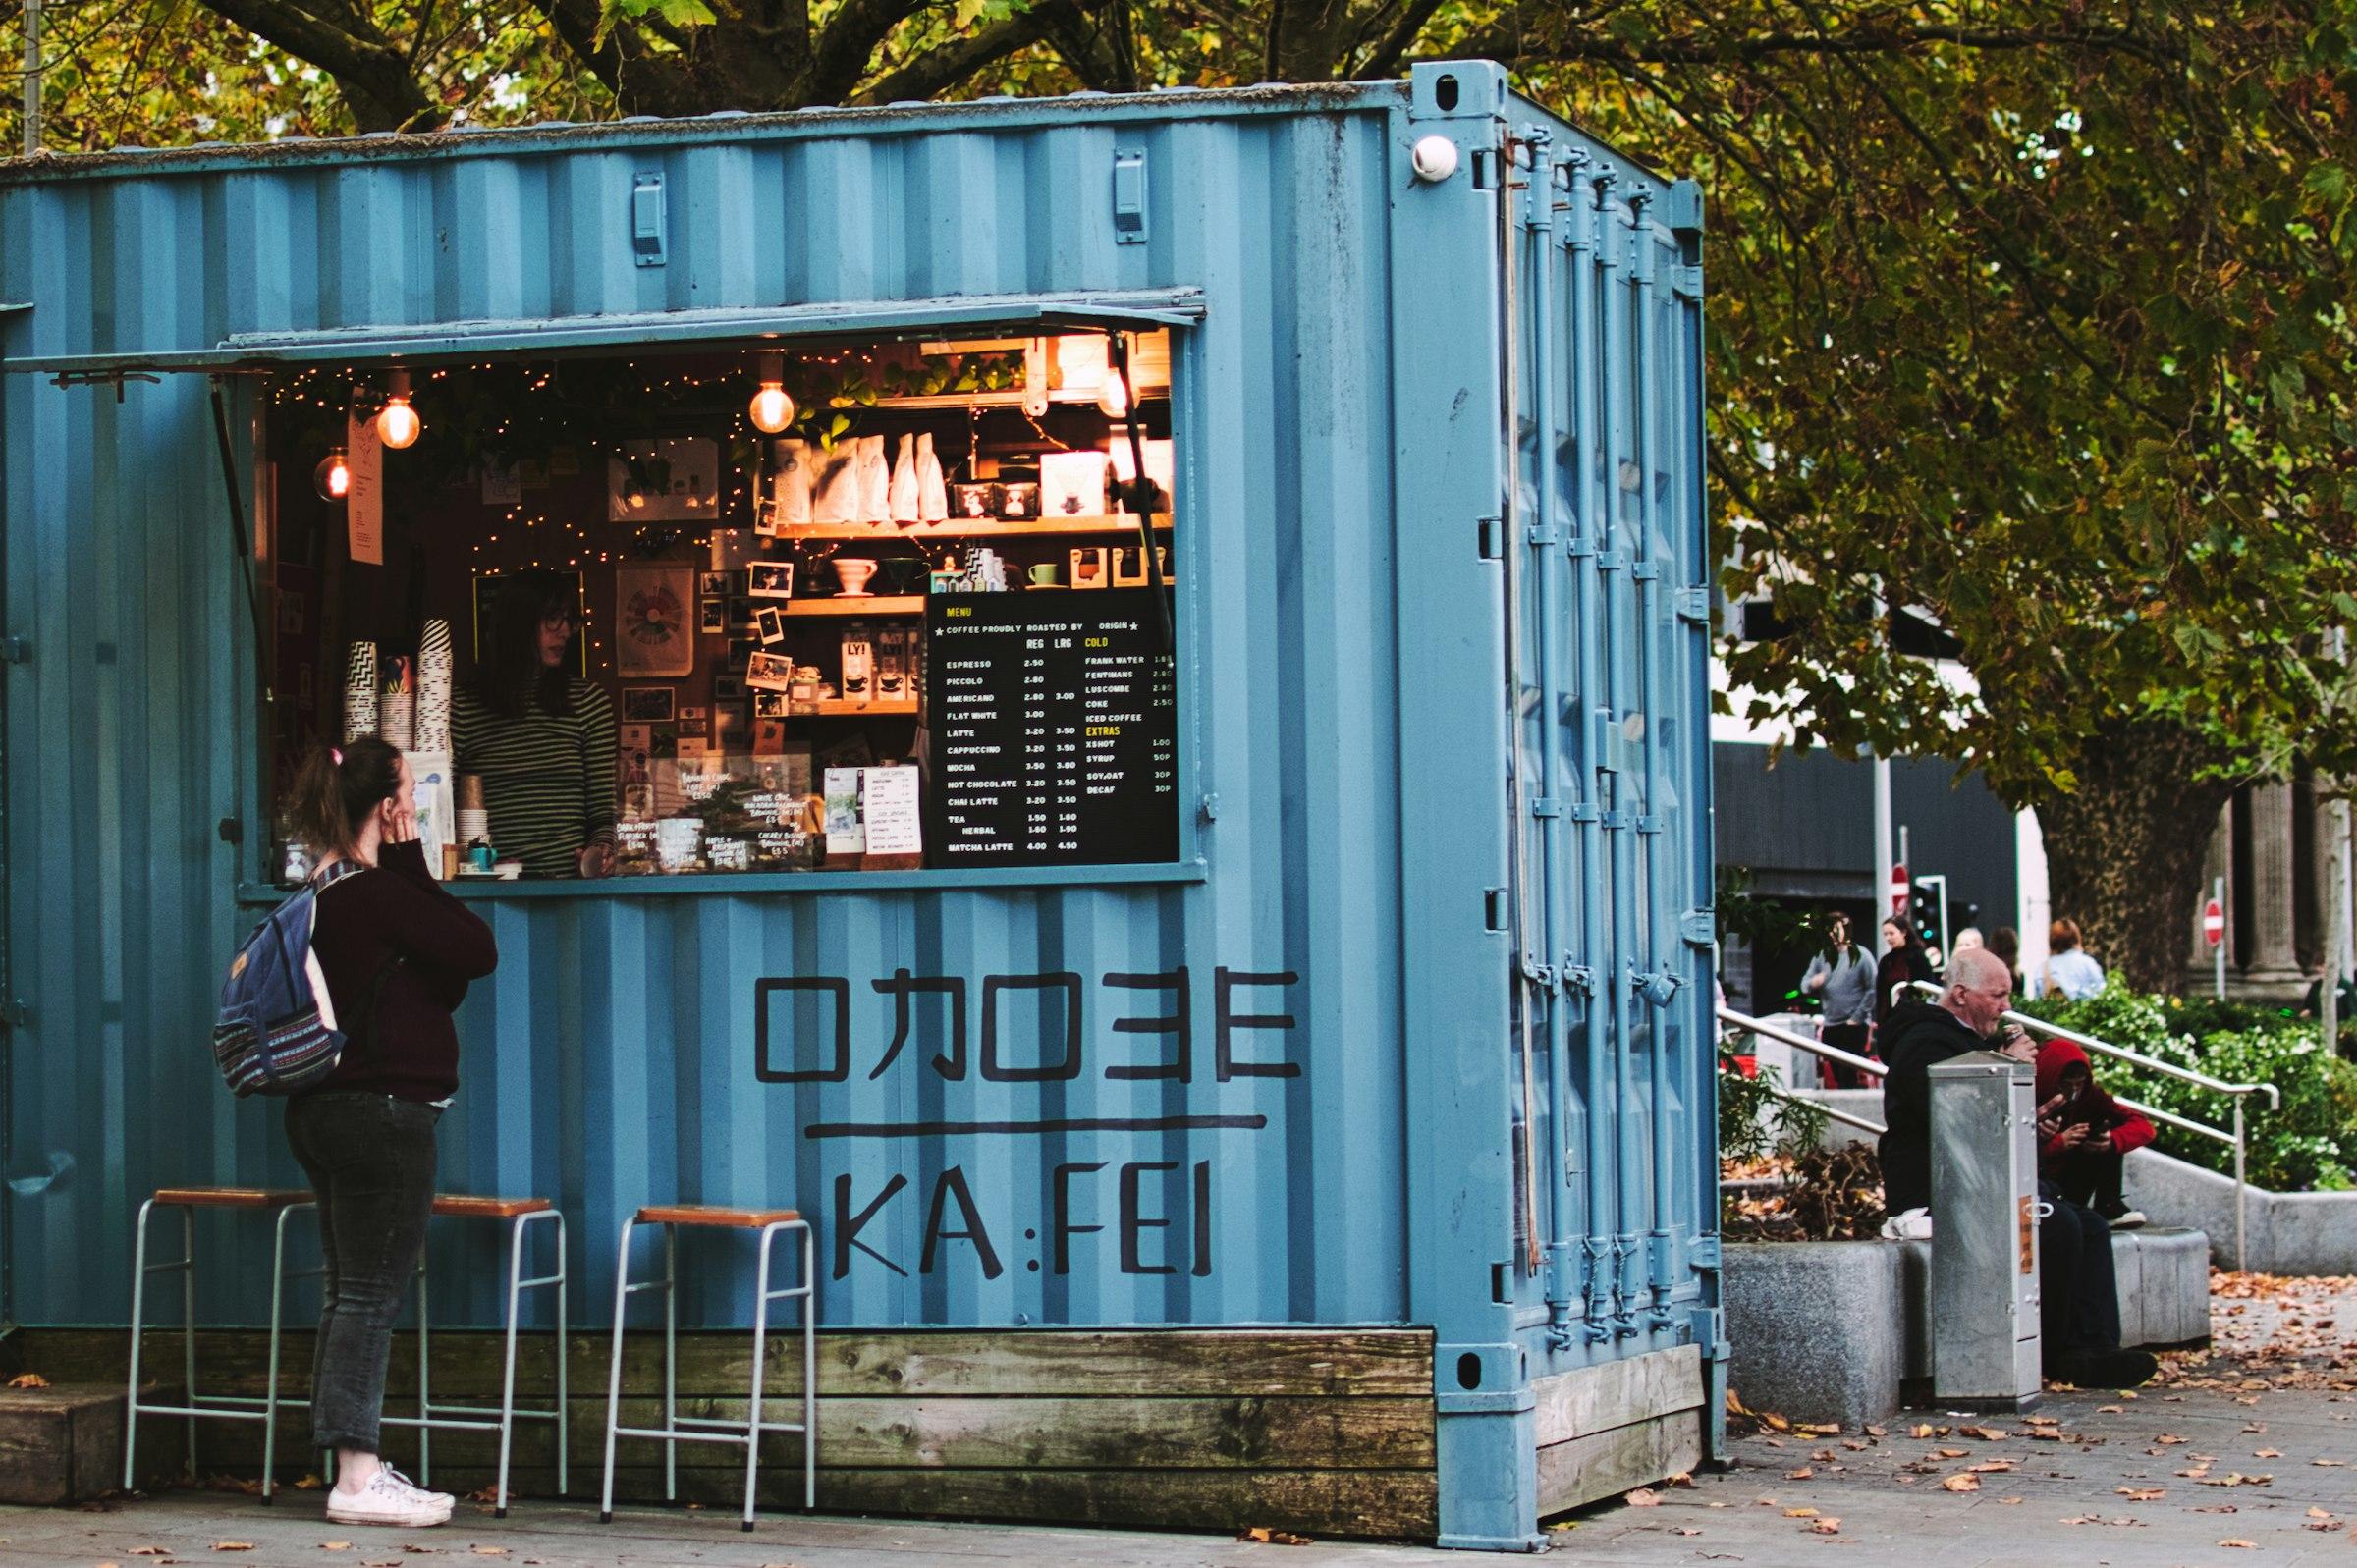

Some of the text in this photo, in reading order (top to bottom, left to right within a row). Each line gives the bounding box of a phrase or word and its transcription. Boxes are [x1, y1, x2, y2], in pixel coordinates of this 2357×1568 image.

[946, 607, 972, 618] MENU
[946, 622, 1128, 635] COFFEE PROUDLY ROASTED BY ORIGIN
[1025, 637, 1072, 650] REG LRG
[1084, 636, 1109, 648] COLD
[848, 644, 865, 655] LY!
[946, 660, 992, 670] ESPRESSO
[1084, 656, 1114, 665] FRANK
[1115, 656, 1145, 665] WATER
[1084, 670, 1133, 680] FENTIMANS
[946, 676, 984, 686] PICCOLO
[1084, 684, 1130, 694] LUSCOMBE
[946, 693, 995, 703] AMERICANO
[1084, 699, 1109, 709] COKE
[946, 711, 970, 721] FLAT
[970, 711, 998, 720] WHITE
[1084, 713, 1143, 723] ICED COFFEE
[946, 729, 975, 738] LATTE
[1024, 728, 1046, 736] 3.20
[1085, 726, 1121, 737] EXTRAS
[946, 745, 1002, 755] CAPPUCCINO
[1024, 744, 1046, 753] 3.20
[1085, 754, 1116, 764] SYRUP
[946, 763, 976, 773] MOCHA
[947, 781, 965, 789] HOT
[965, 780, 1018, 789] CHOCOLATE
[1025, 779, 1046, 787] 3.20
[1086, 785, 1116, 795] DECAF
[947, 797, 969, 807] CHAI
[969, 796, 999, 807] LATTE
[1025, 796, 1047, 805] 3.20
[947, 815, 966, 824] TEA
[961, 826, 997, 836] HERBAL
[948, 843, 984, 852] MATCHA
[984, 842, 1014, 852] LATTE
